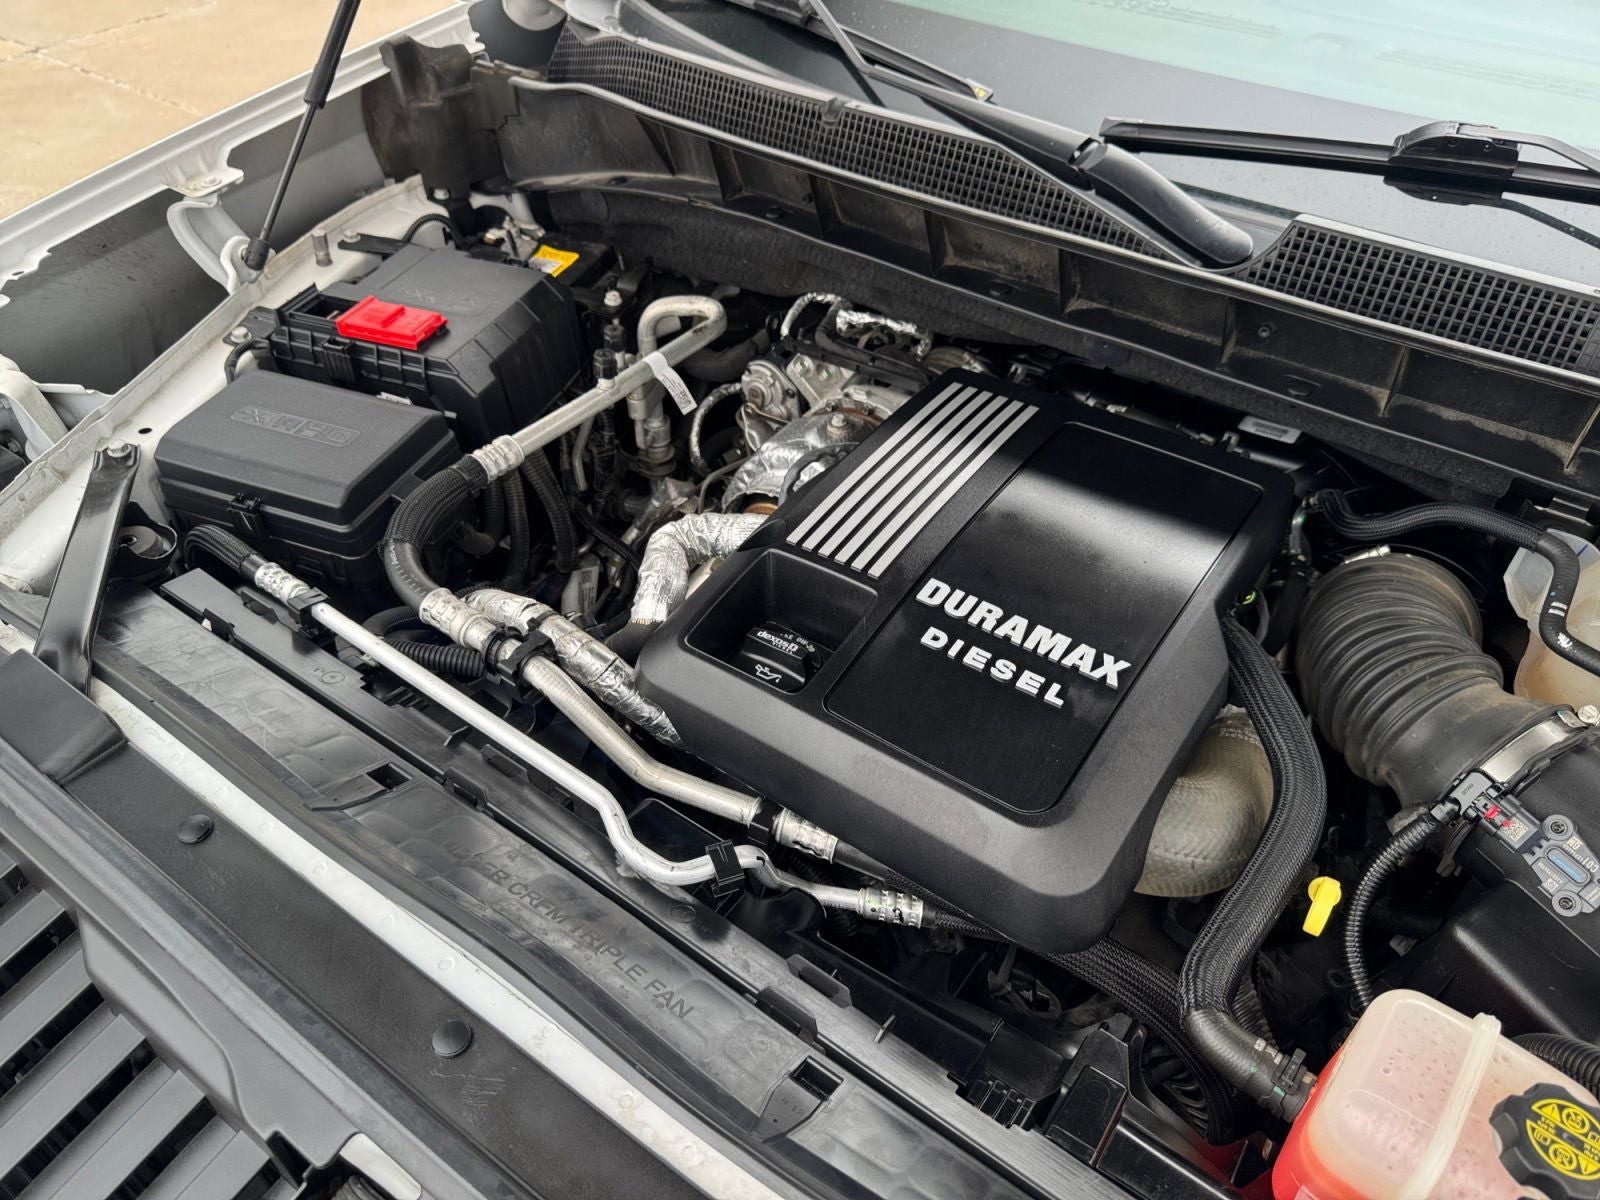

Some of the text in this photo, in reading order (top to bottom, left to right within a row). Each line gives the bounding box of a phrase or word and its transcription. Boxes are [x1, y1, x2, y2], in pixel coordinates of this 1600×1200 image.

[915, 577, 1132, 690] DURAMAX
[920, 626, 1065, 708] DIESEL
[569, 924, 648, 983] TRIPLE
[643, 978, 695, 1020] FAN
